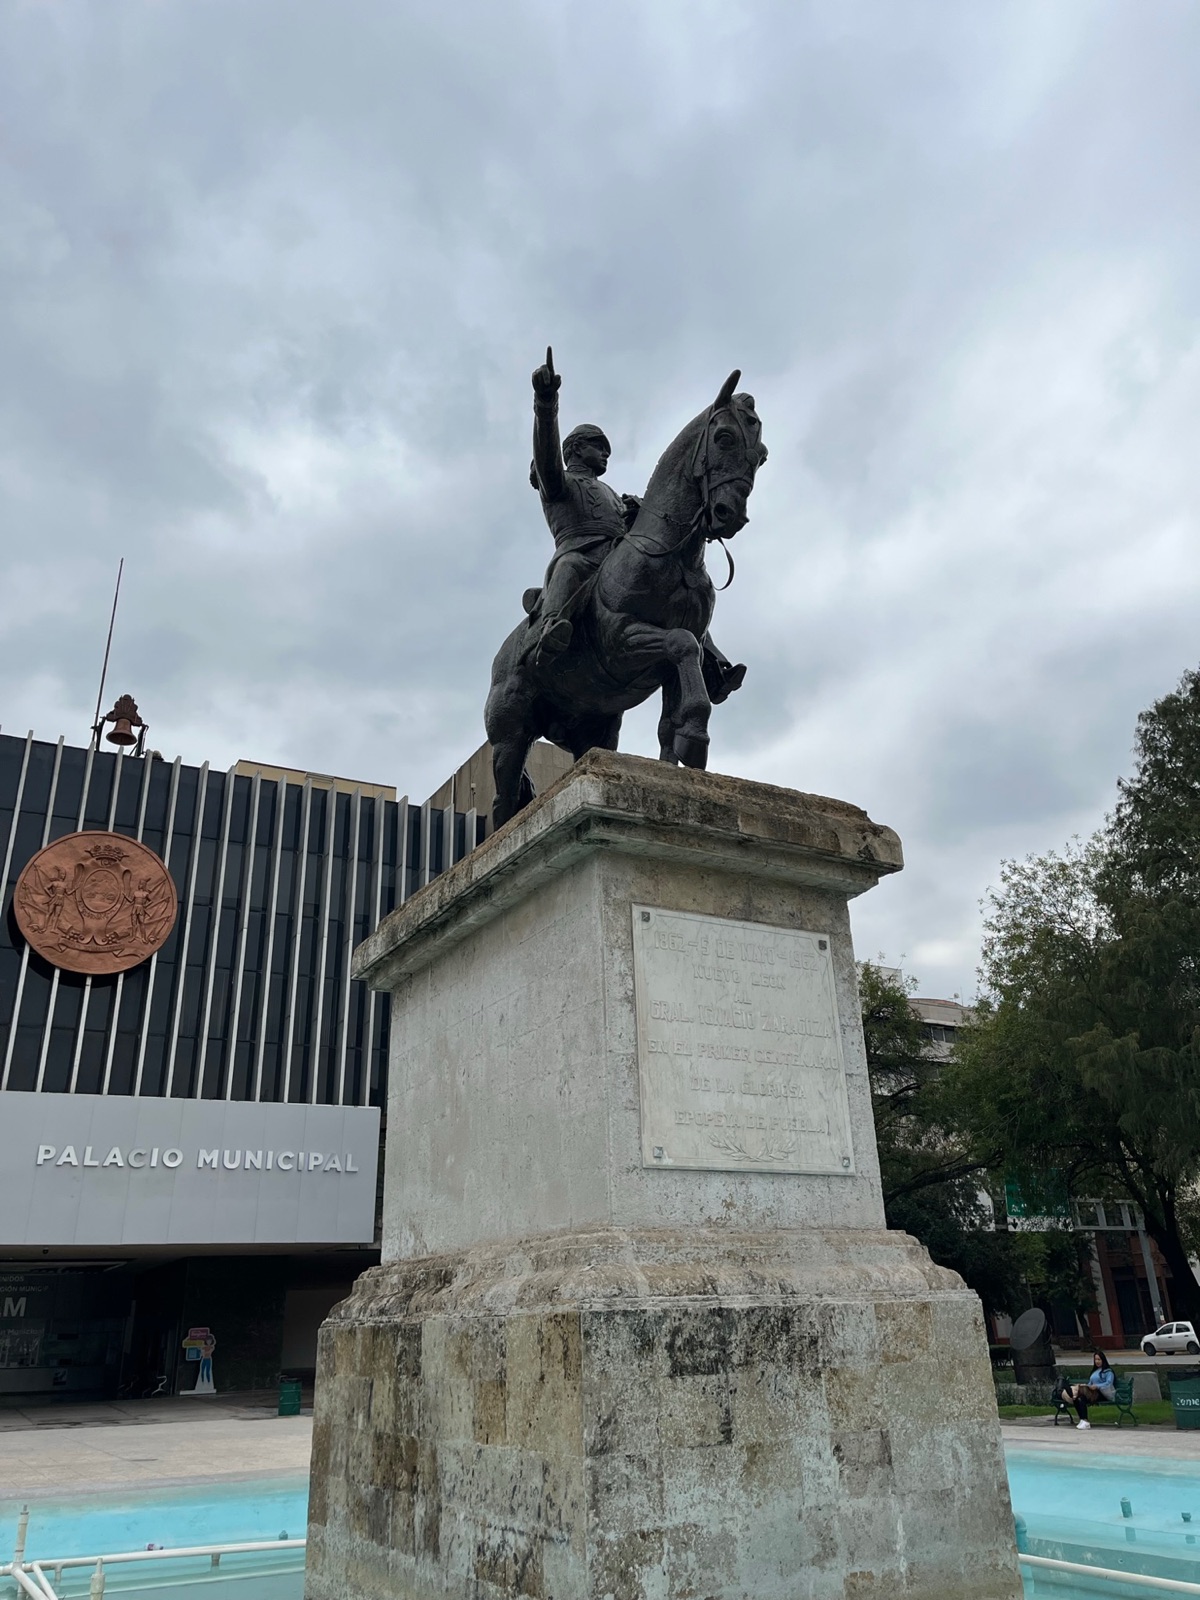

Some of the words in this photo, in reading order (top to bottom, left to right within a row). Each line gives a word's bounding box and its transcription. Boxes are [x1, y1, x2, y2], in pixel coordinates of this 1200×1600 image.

[715, 938, 735, 960] DE
[692, 964, 741, 983] NUEVO
[751, 972, 786, 990] LEON
[733, 992, 752, 1006] AL
[650, 1000, 694, 1024] GRAL.
[698, 1004, 756, 1030] IGNACIO
[760, 1012, 832, 1039] ZARAGOZA
[647, 1038, 668, 1054] EN
[673, 1040, 693, 1057] EL
[697, 1043, 752, 1063] PRIMER
[755, 1049, 840, 1072] CENTENARIO
[690, 1077, 711, 1092] DE
[715, 1078, 736, 1094] LA
[740, 1082, 806, 1099] GLORIOSA
[675, 1110, 741, 1128] EPOPEYA
[745, 1115, 767, 1131] DE
[769, 1116, 826, 1134] PUEBLA
[36, 1144, 184, 1168] PALACIO
[197, 1148, 359, 1173] MUNICIPAL
